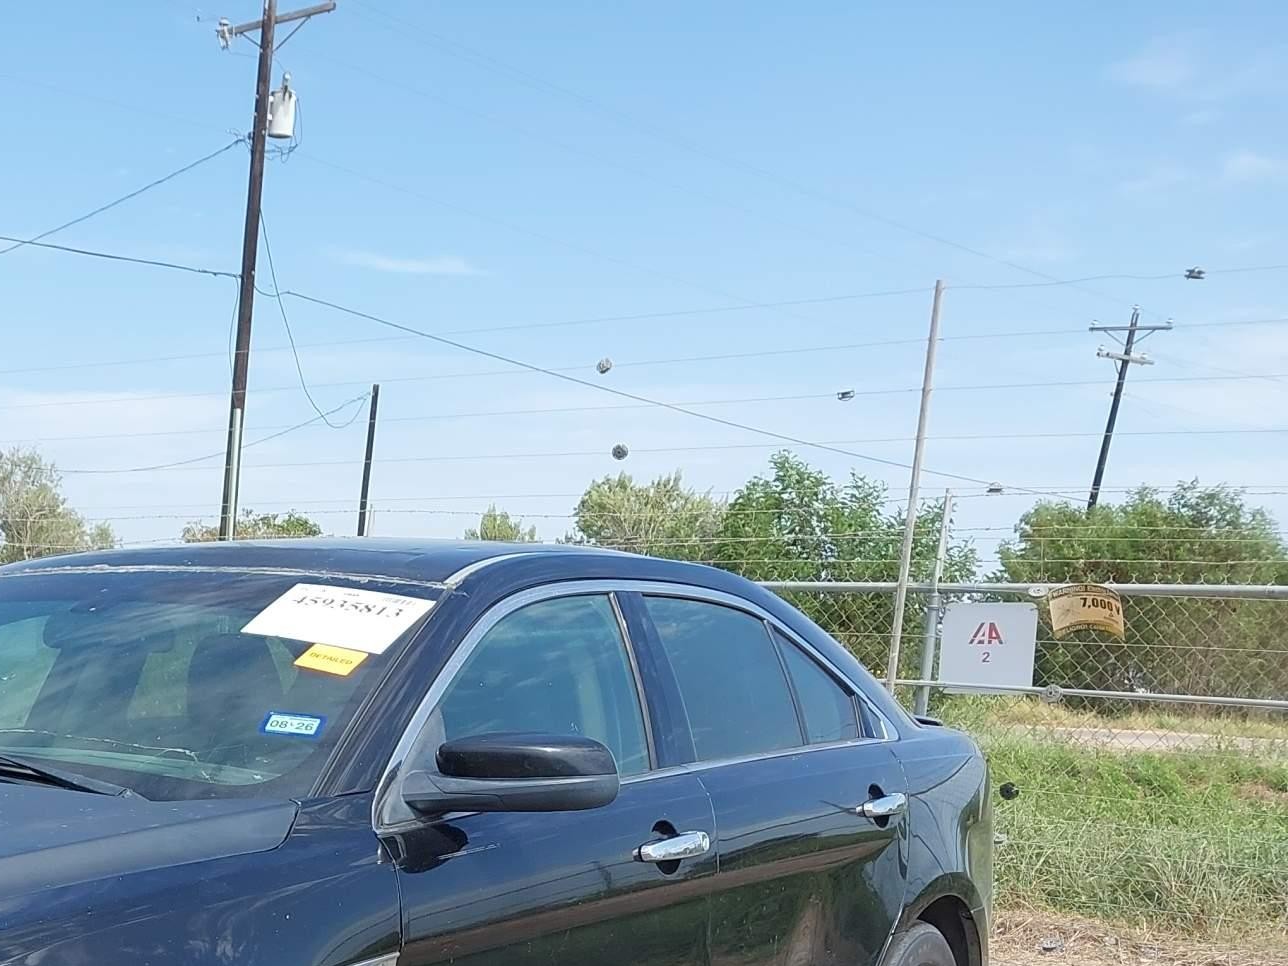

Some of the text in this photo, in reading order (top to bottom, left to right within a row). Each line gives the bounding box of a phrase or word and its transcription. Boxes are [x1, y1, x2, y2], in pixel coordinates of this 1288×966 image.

[292, 596, 404, 618] 45935813
[1080, 597, 1121, 616] 7,000 V
[309, 652, 354, 666] DETAILED
[982, 651, 991, 663] 2
[270, 720, 314, 731] 08 26
